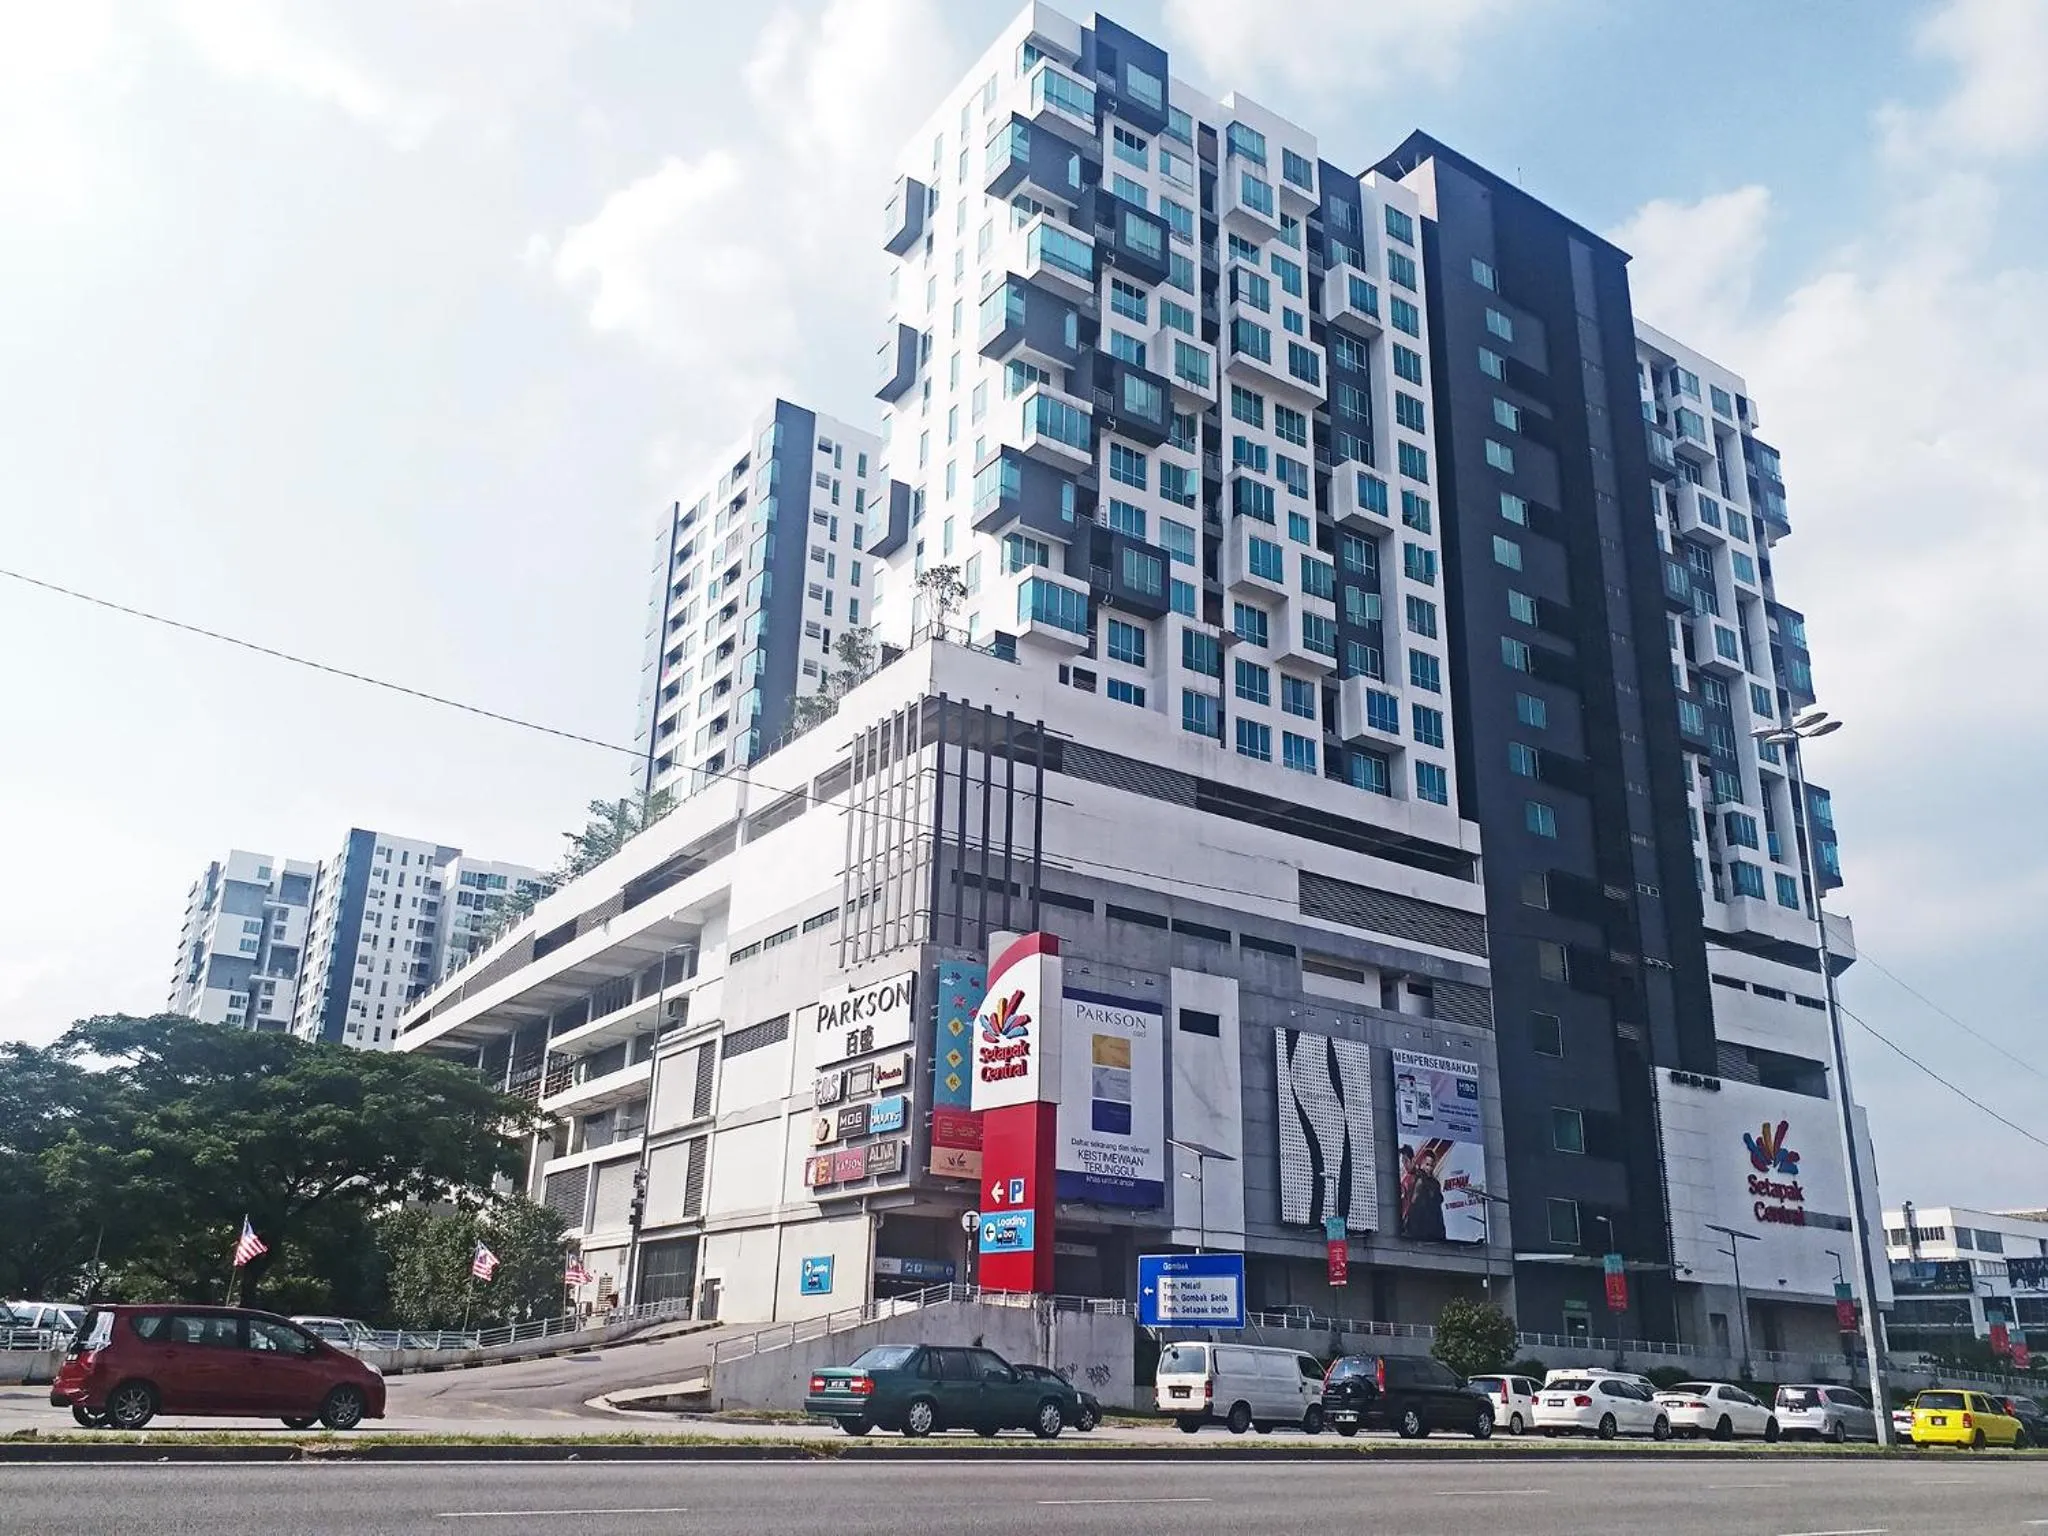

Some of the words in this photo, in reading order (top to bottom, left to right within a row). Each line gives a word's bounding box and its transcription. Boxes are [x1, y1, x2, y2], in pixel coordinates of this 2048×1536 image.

[817, 980, 910, 1033] PARKSON
[1076, 1004, 1147, 1029] PARKSON
[979, 1039, 1031, 1064] Setapak
[981, 1059, 1028, 1082] Central
[1394, 1051, 1478, 1076] MEMPERSEMBAHKAN
[1078, 1149, 1144, 1167] KEISTIMEWAAN
[1084, 1161, 1138, 1178] TERUNGGUL
[1011, 1181, 1022, 1202] P
[1747, 1174, 1805, 1203] Setapak
[997, 1214, 1026, 1228] Loading
[1754, 1201, 1805, 1226] Central
[1163, 1262, 1189, 1271] Gombak
[1181, 1281, 1201, 1290] Melati
[1181, 1293, 1208, 1303] Gombak
[1211, 1293, 1228, 1302] Setia
[1181, 1305, 1208, 1315] Setapak
